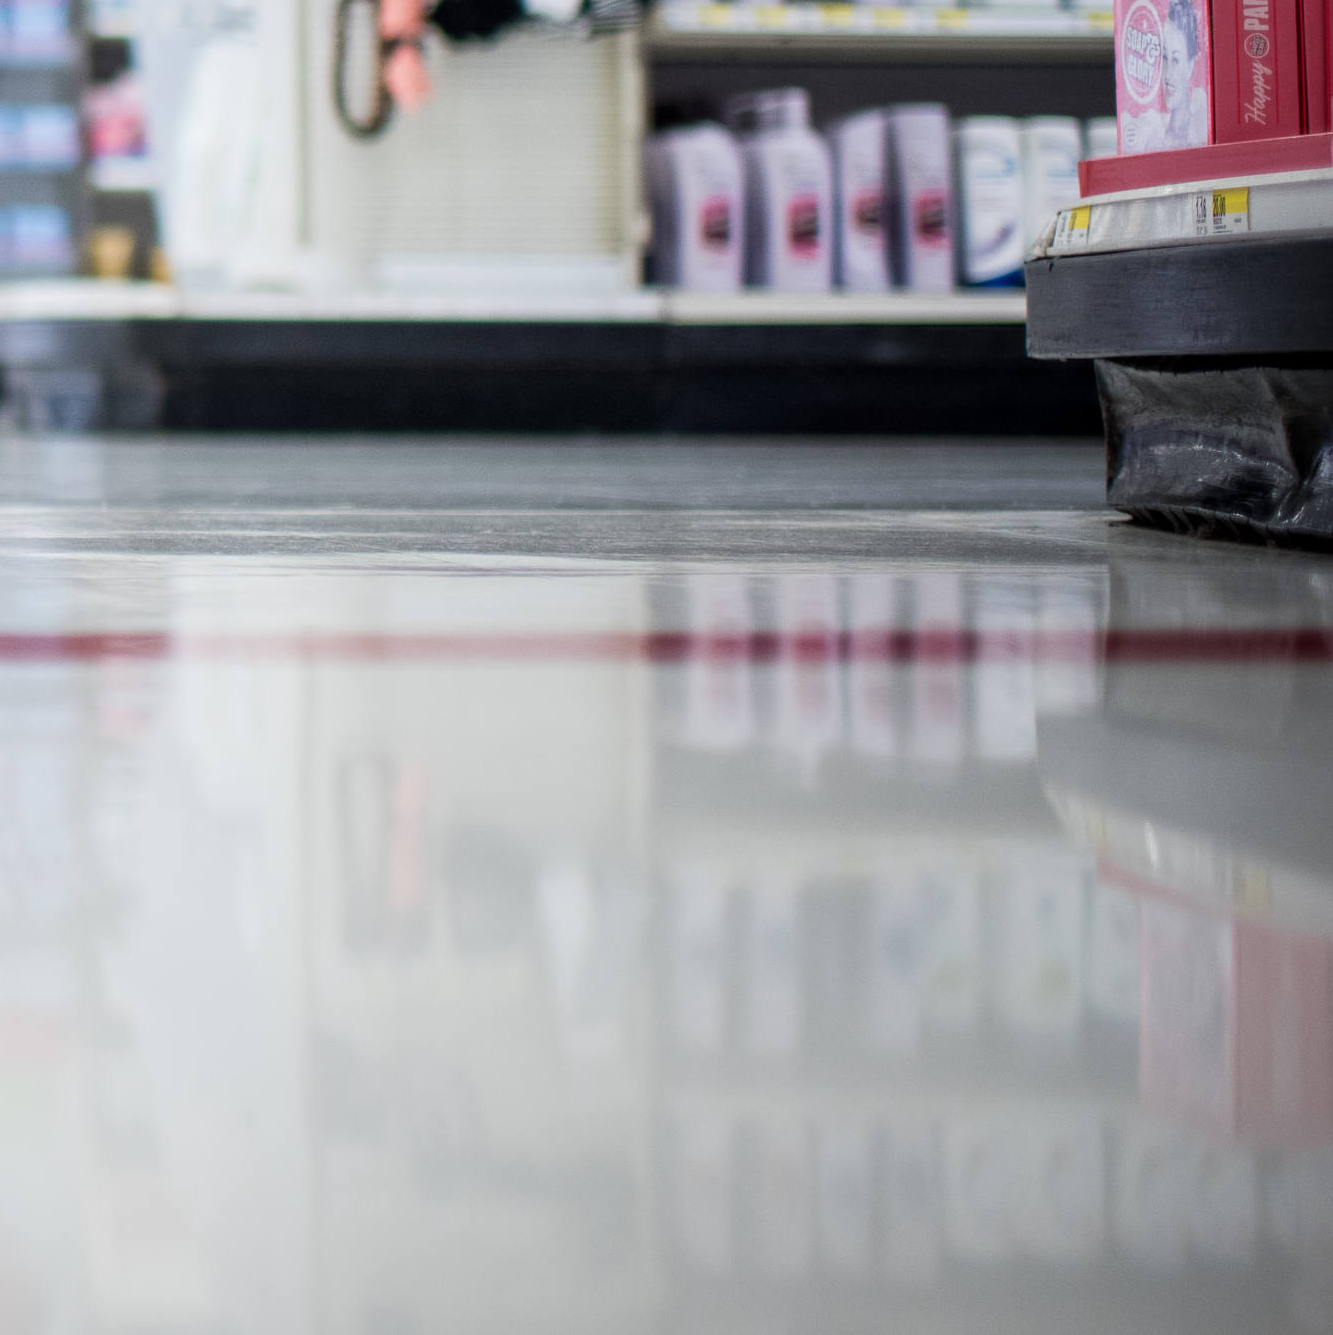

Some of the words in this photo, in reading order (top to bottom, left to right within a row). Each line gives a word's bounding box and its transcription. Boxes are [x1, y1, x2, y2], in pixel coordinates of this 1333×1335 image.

[1126, 25, 1147, 56] SOAP
[1127, 52, 1155, 87] GLORY
[1245, 60, 1273, 126] Happy
